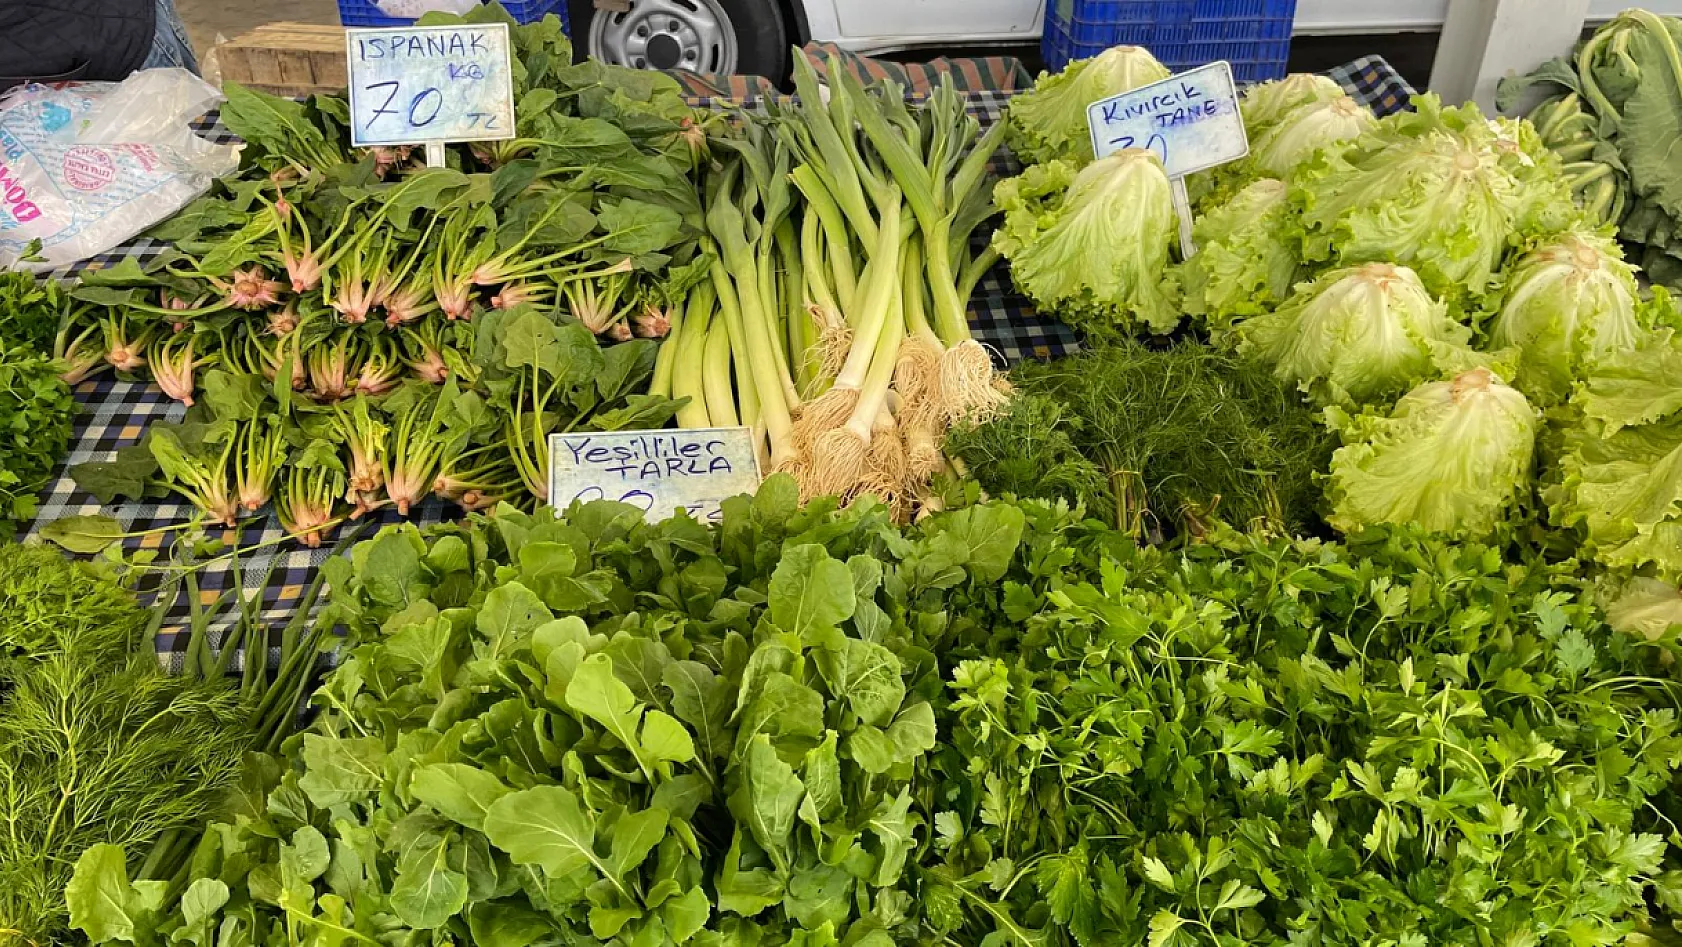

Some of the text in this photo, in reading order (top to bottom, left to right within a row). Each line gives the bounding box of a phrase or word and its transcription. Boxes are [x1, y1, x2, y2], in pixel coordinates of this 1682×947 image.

[359, 33, 489, 61] ISPANAK
[448, 61, 485, 81] KG
[365, 80, 499, 131] 70 TL
[1155, 100, 1217, 128] TANE
[605, 456, 732, 480] TARLA
